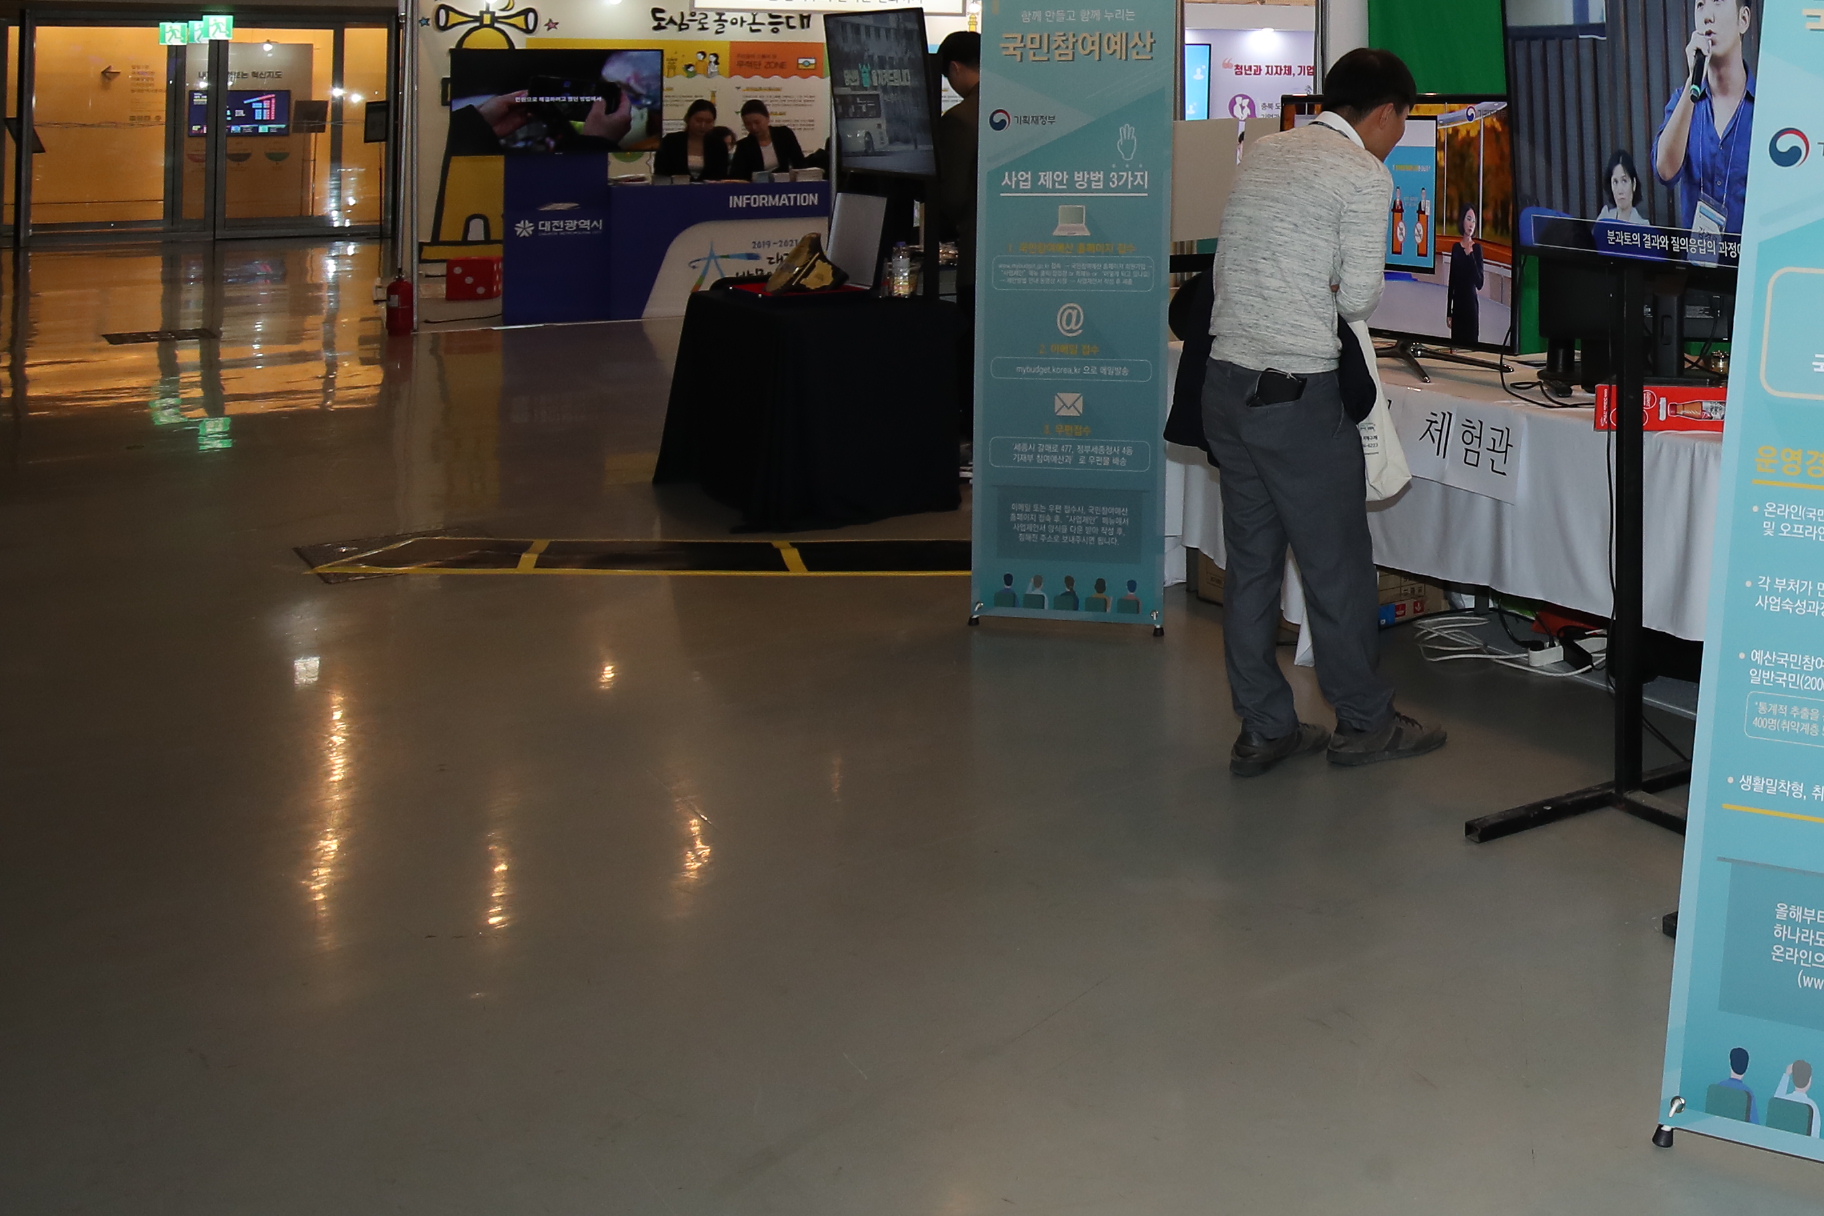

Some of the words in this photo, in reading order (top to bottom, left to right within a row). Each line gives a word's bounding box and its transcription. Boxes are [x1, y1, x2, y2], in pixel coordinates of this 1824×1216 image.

[1000, 32, 1156, 63] 국민참여예산
[1234, 65, 1262, 76] 청년과
[1265, 65, 1295, 77] 지자체,
[1014, 115, 1056, 126] 기획재정부
[1002, 172, 1031, 189] 사업
[1038, 172, 1068, 189] 제안
[1074, 172, 1103, 189] 방법
[1109, 172, 1148, 189] 3가지
[729, 193, 818, 208] INFORMATION
[539, 220, 602, 231] 대전광역시
[1607, 230, 1640, 247] 분과토의
[1643, 234, 1669, 250] 결과와
[1671, 237, 1716, 255] 질의응답의
[1083, 367, 1098, 375] 으로
[1419, 411, 1514, 476] 체험관
[1739, 773, 1808, 800] 생활밀착형,
